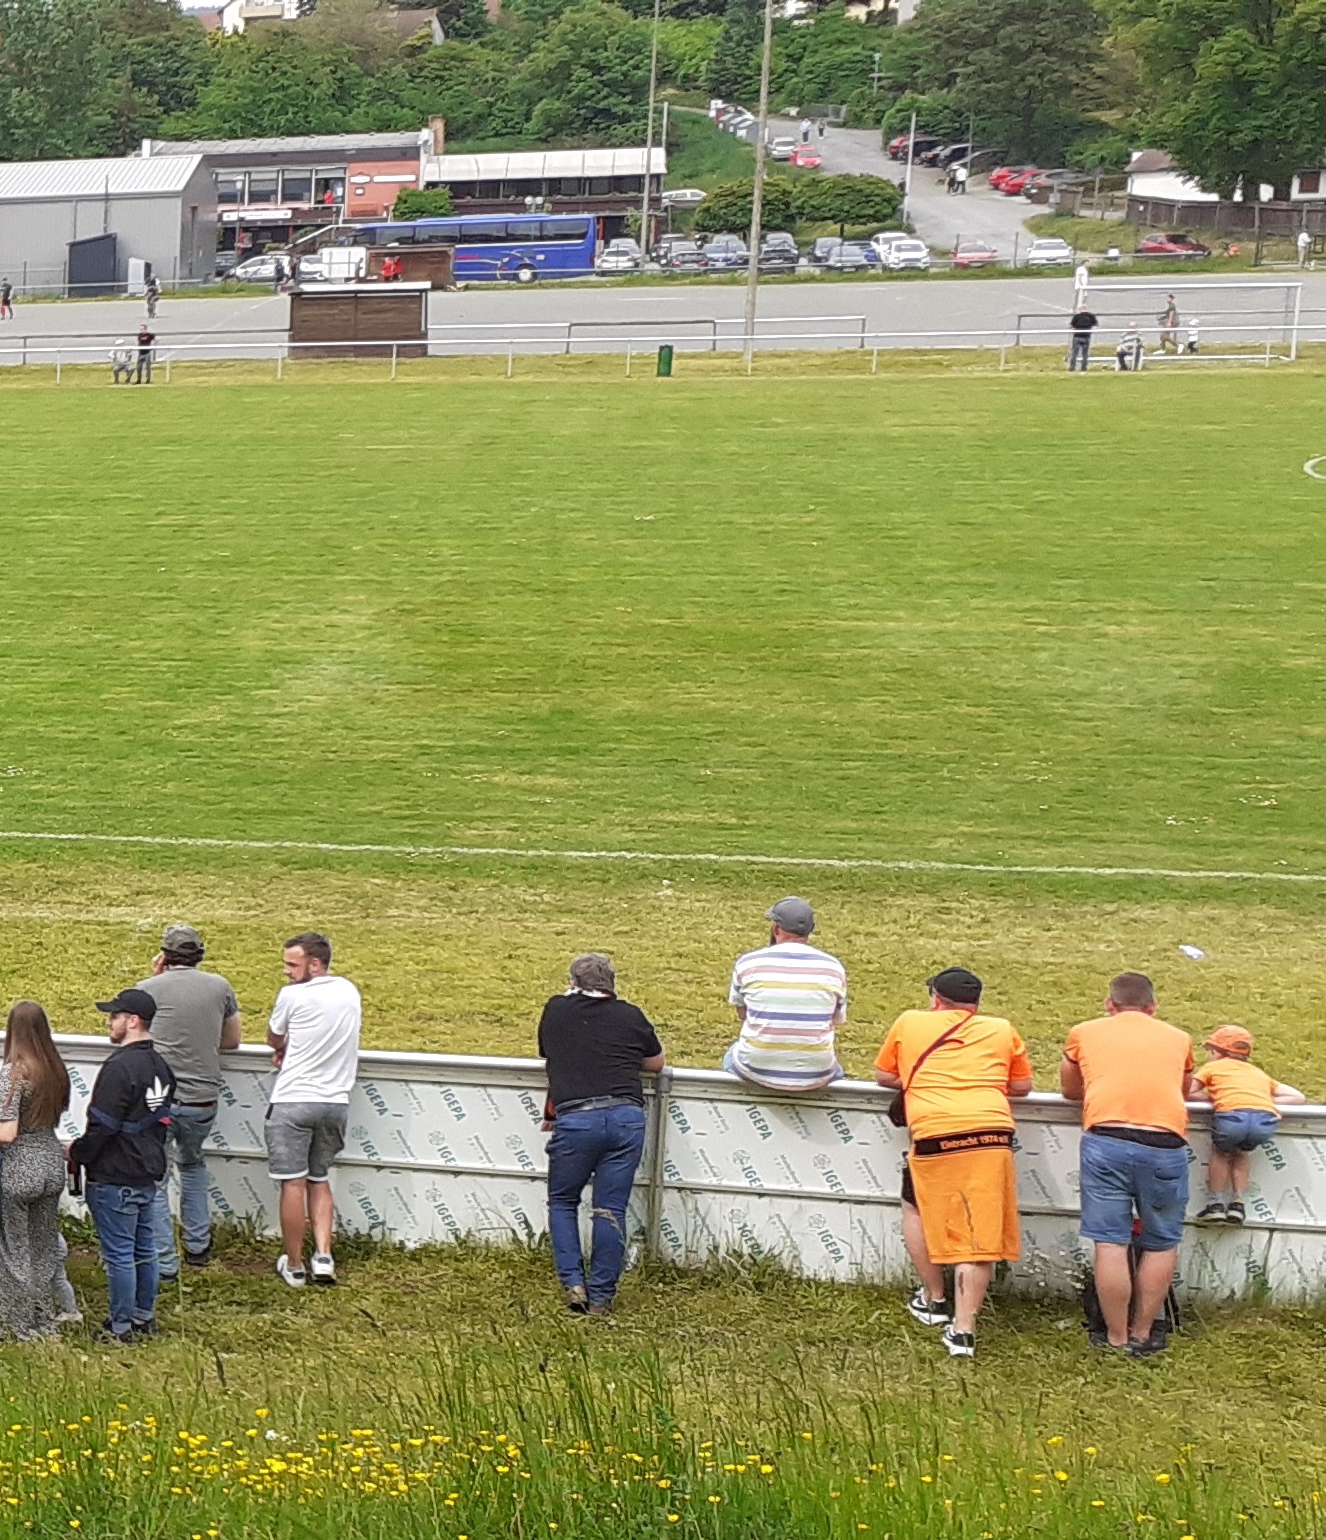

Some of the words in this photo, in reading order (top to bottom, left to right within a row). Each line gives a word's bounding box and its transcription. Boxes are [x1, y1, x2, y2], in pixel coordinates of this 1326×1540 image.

[68, 1066, 91, 1099] IGEPA
[218, 1078, 238, 1108] GEPA
[361, 1083, 390, 1117] IGEPA
[440, 1088, 467, 1122] IGEPA
[517, 1091, 544, 1126] IGEPA
[668, 1100, 692, 1136] IGEPA
[745, 1105, 773, 1141] IGEPA
[826, 1109, 855, 1145] IGEPA
[1260, 1140, 1288, 1172] GEPA
[208, 1186, 235, 1218] IGEPA
[357, 1197, 386, 1231] IGEPA
[434, 1203, 461, 1237] IGEPA
[817, 1229, 846, 1265] IGEPA
